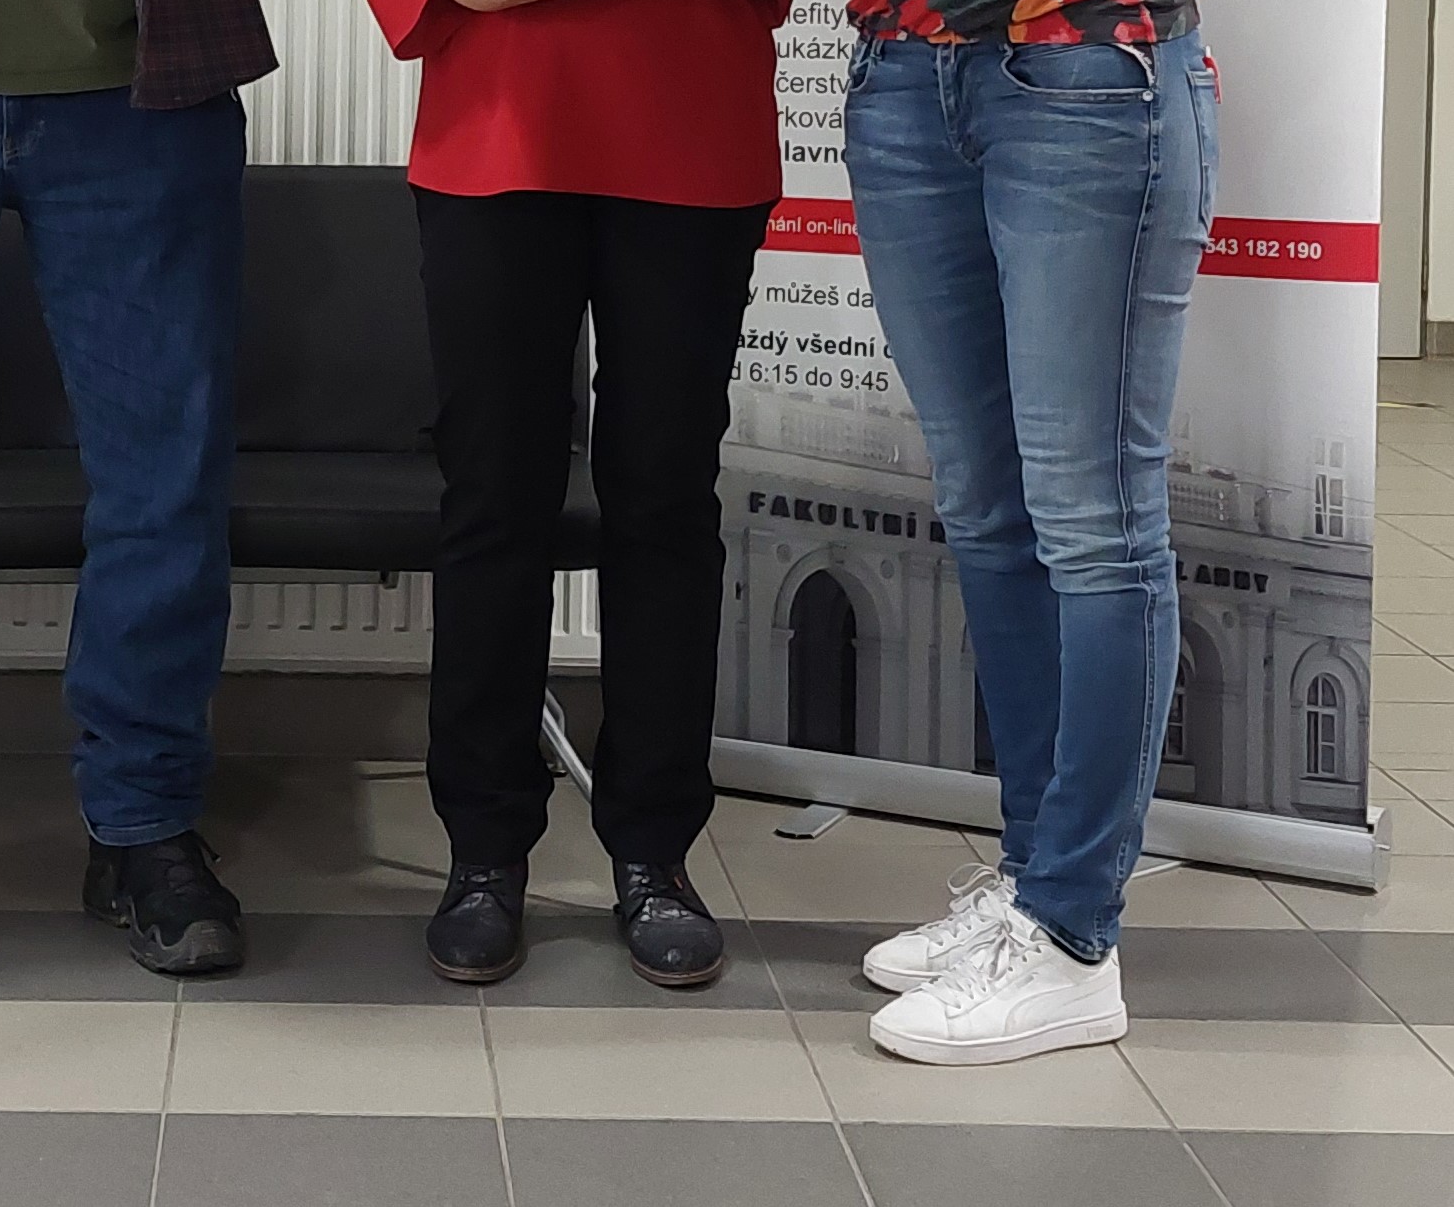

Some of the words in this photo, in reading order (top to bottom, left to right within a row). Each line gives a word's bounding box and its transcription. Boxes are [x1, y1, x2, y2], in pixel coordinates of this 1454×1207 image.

[1245, 239, 1280, 258] 182
[1286, 241, 1322, 260] 190
[766, 281, 840, 306] můžeš
[795, 332, 876, 358] všední
[749, 361, 798, 385] 6:15
[805, 366, 833, 387] do
[840, 369, 890, 392] 9:45
